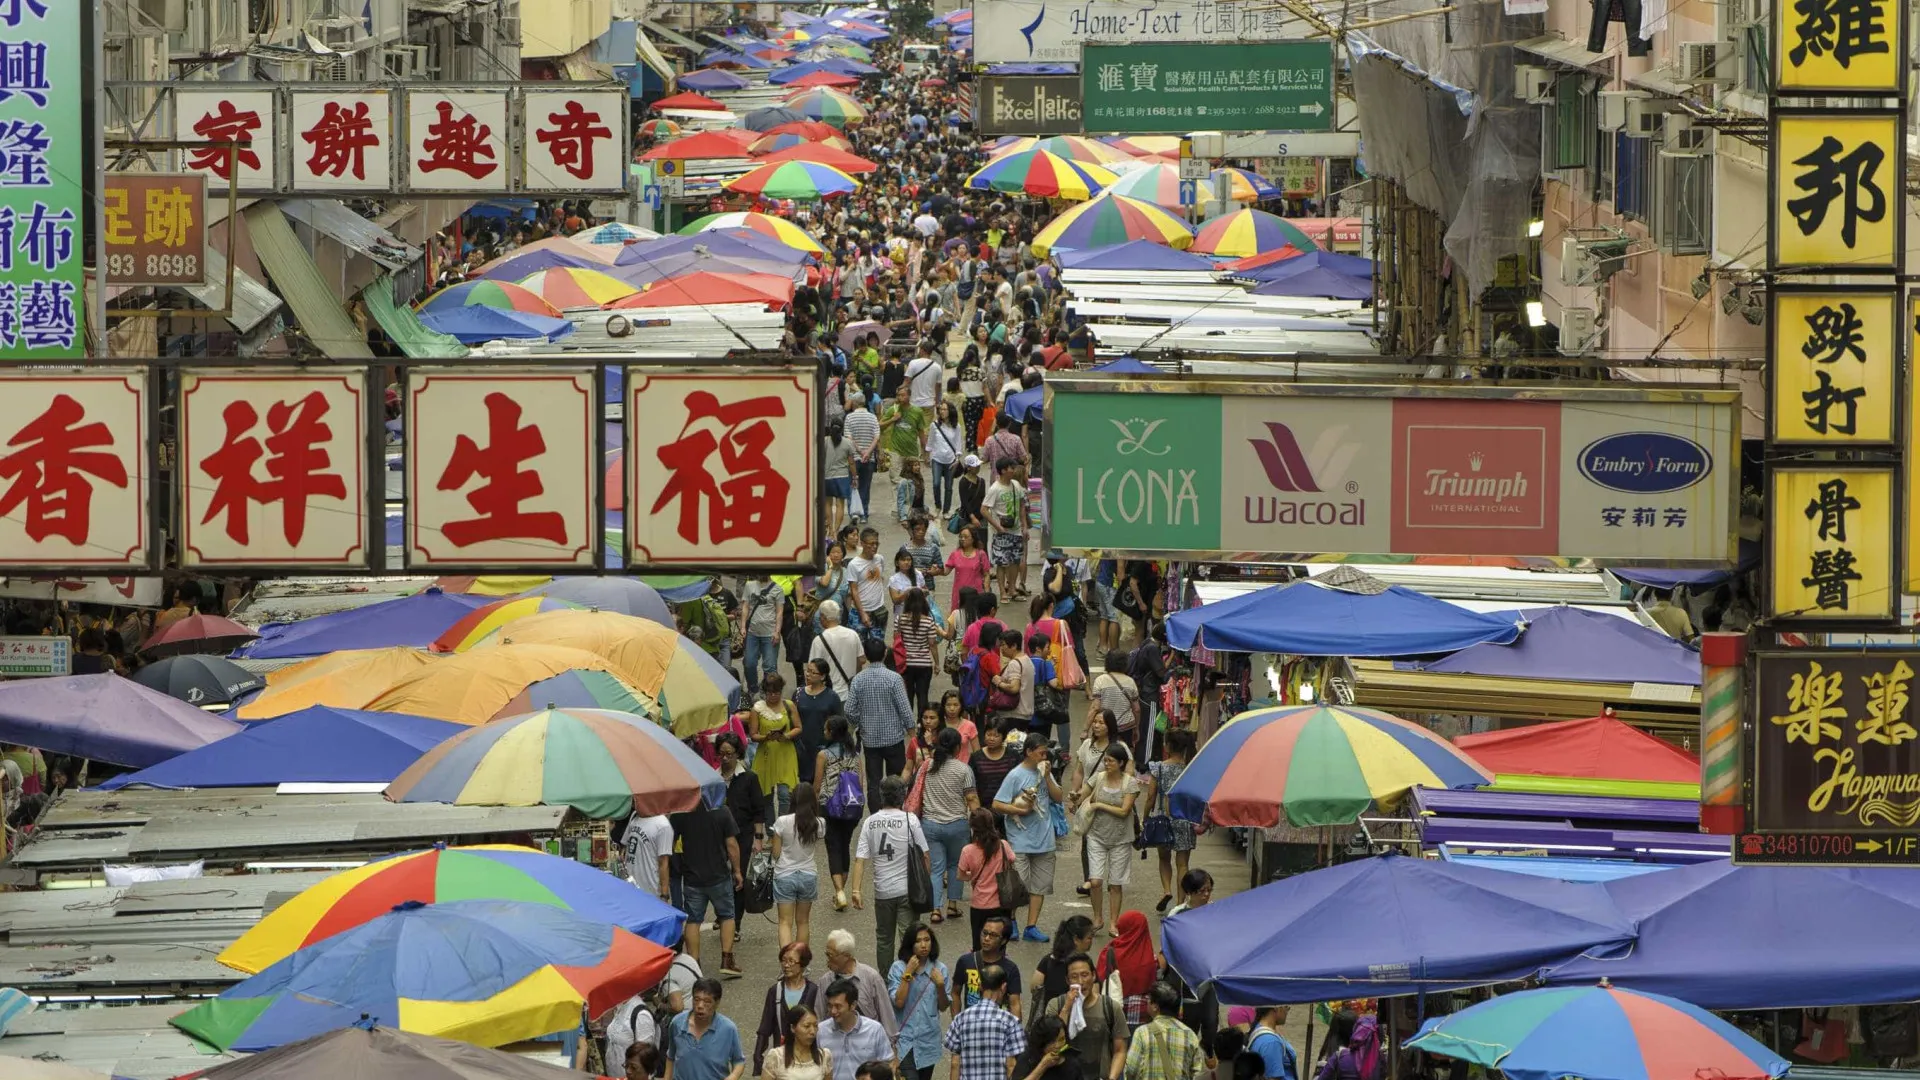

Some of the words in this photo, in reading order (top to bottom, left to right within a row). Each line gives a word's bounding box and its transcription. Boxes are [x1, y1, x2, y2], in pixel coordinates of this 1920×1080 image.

[1070, 0, 1182, 35] Home-Text
[1165, 69, 1324, 85] 醫療用品配套有限公司
[146, 254, 197, 277] 8698
[1591, 456, 1646, 477] Embry
[1657, 456, 1700, 475] Form
[1077, 467, 1198, 526] LEONA
[1423, 468, 1528, 503] Triumph
[1244, 495, 1365, 527] Wacoal
[1430, 504, 1522, 514] INTERNATIONAL
[1601, 507, 1688, 528] 安莉芳
[869, 820, 903, 830] GERRARD
[879, 832, 895, 861] 4
[1767, 835, 1853, 855] 34810700
[1885, 837, 1917, 855] 1/F
